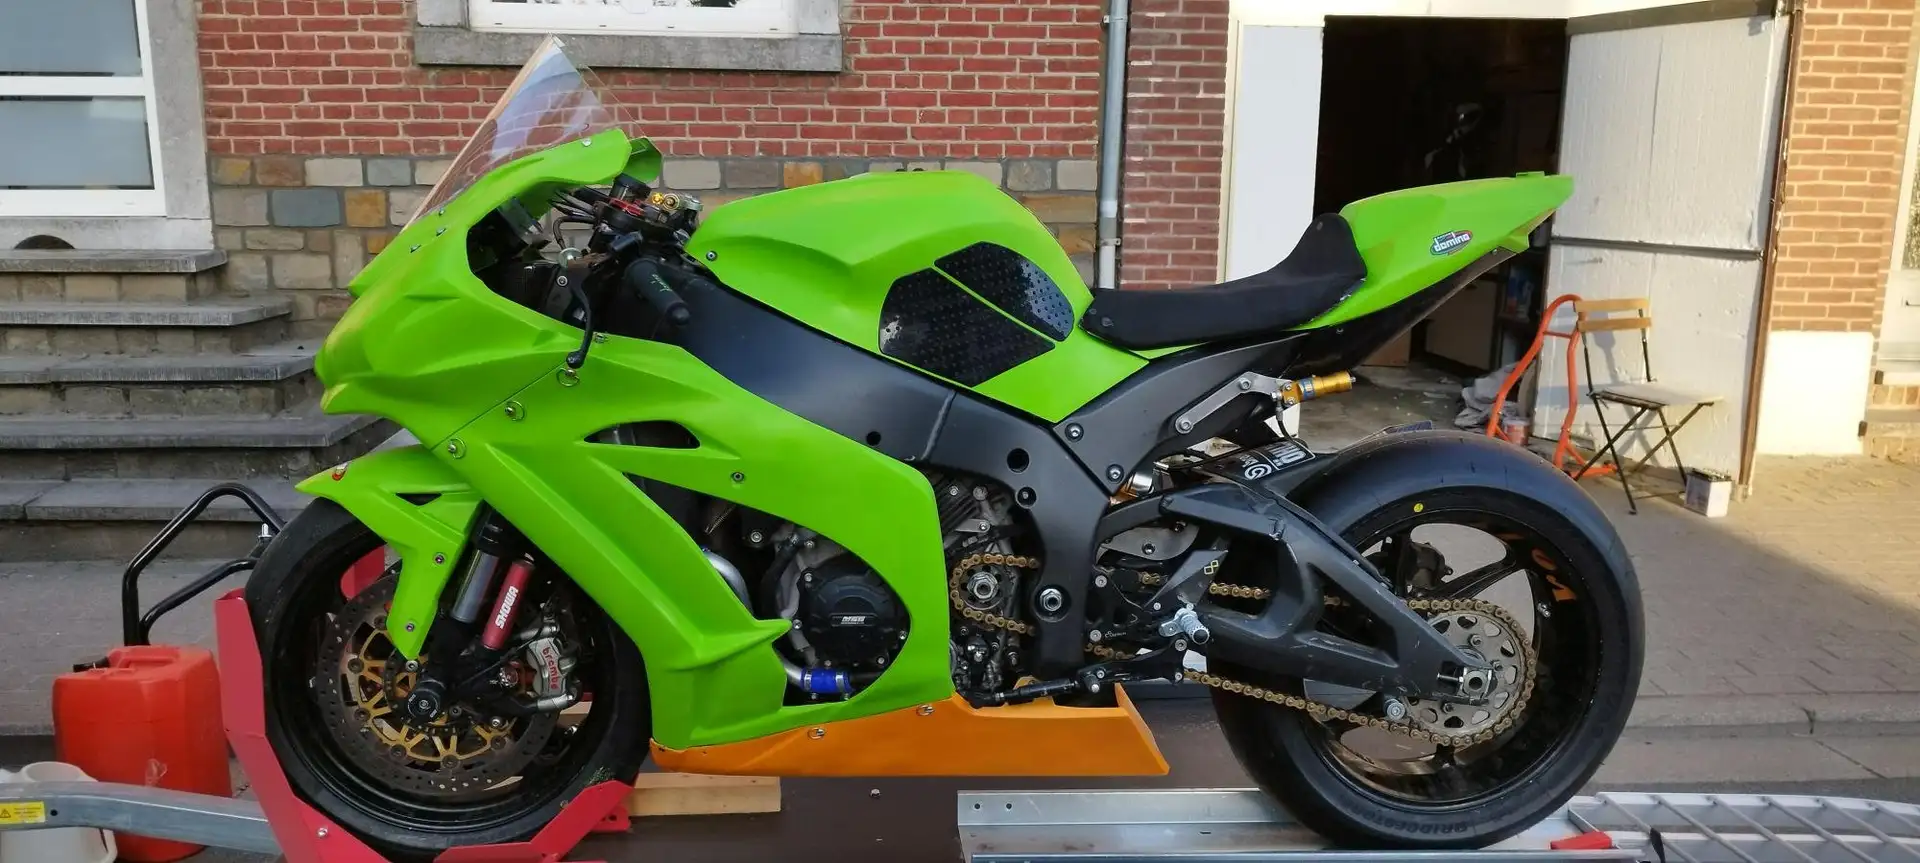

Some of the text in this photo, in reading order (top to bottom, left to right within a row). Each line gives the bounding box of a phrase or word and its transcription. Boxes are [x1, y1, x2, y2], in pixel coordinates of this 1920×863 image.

[1433, 231, 1471, 252] domino
[494, 585, 519, 629] SHOWA
[543, 647, 560, 690] brembo
